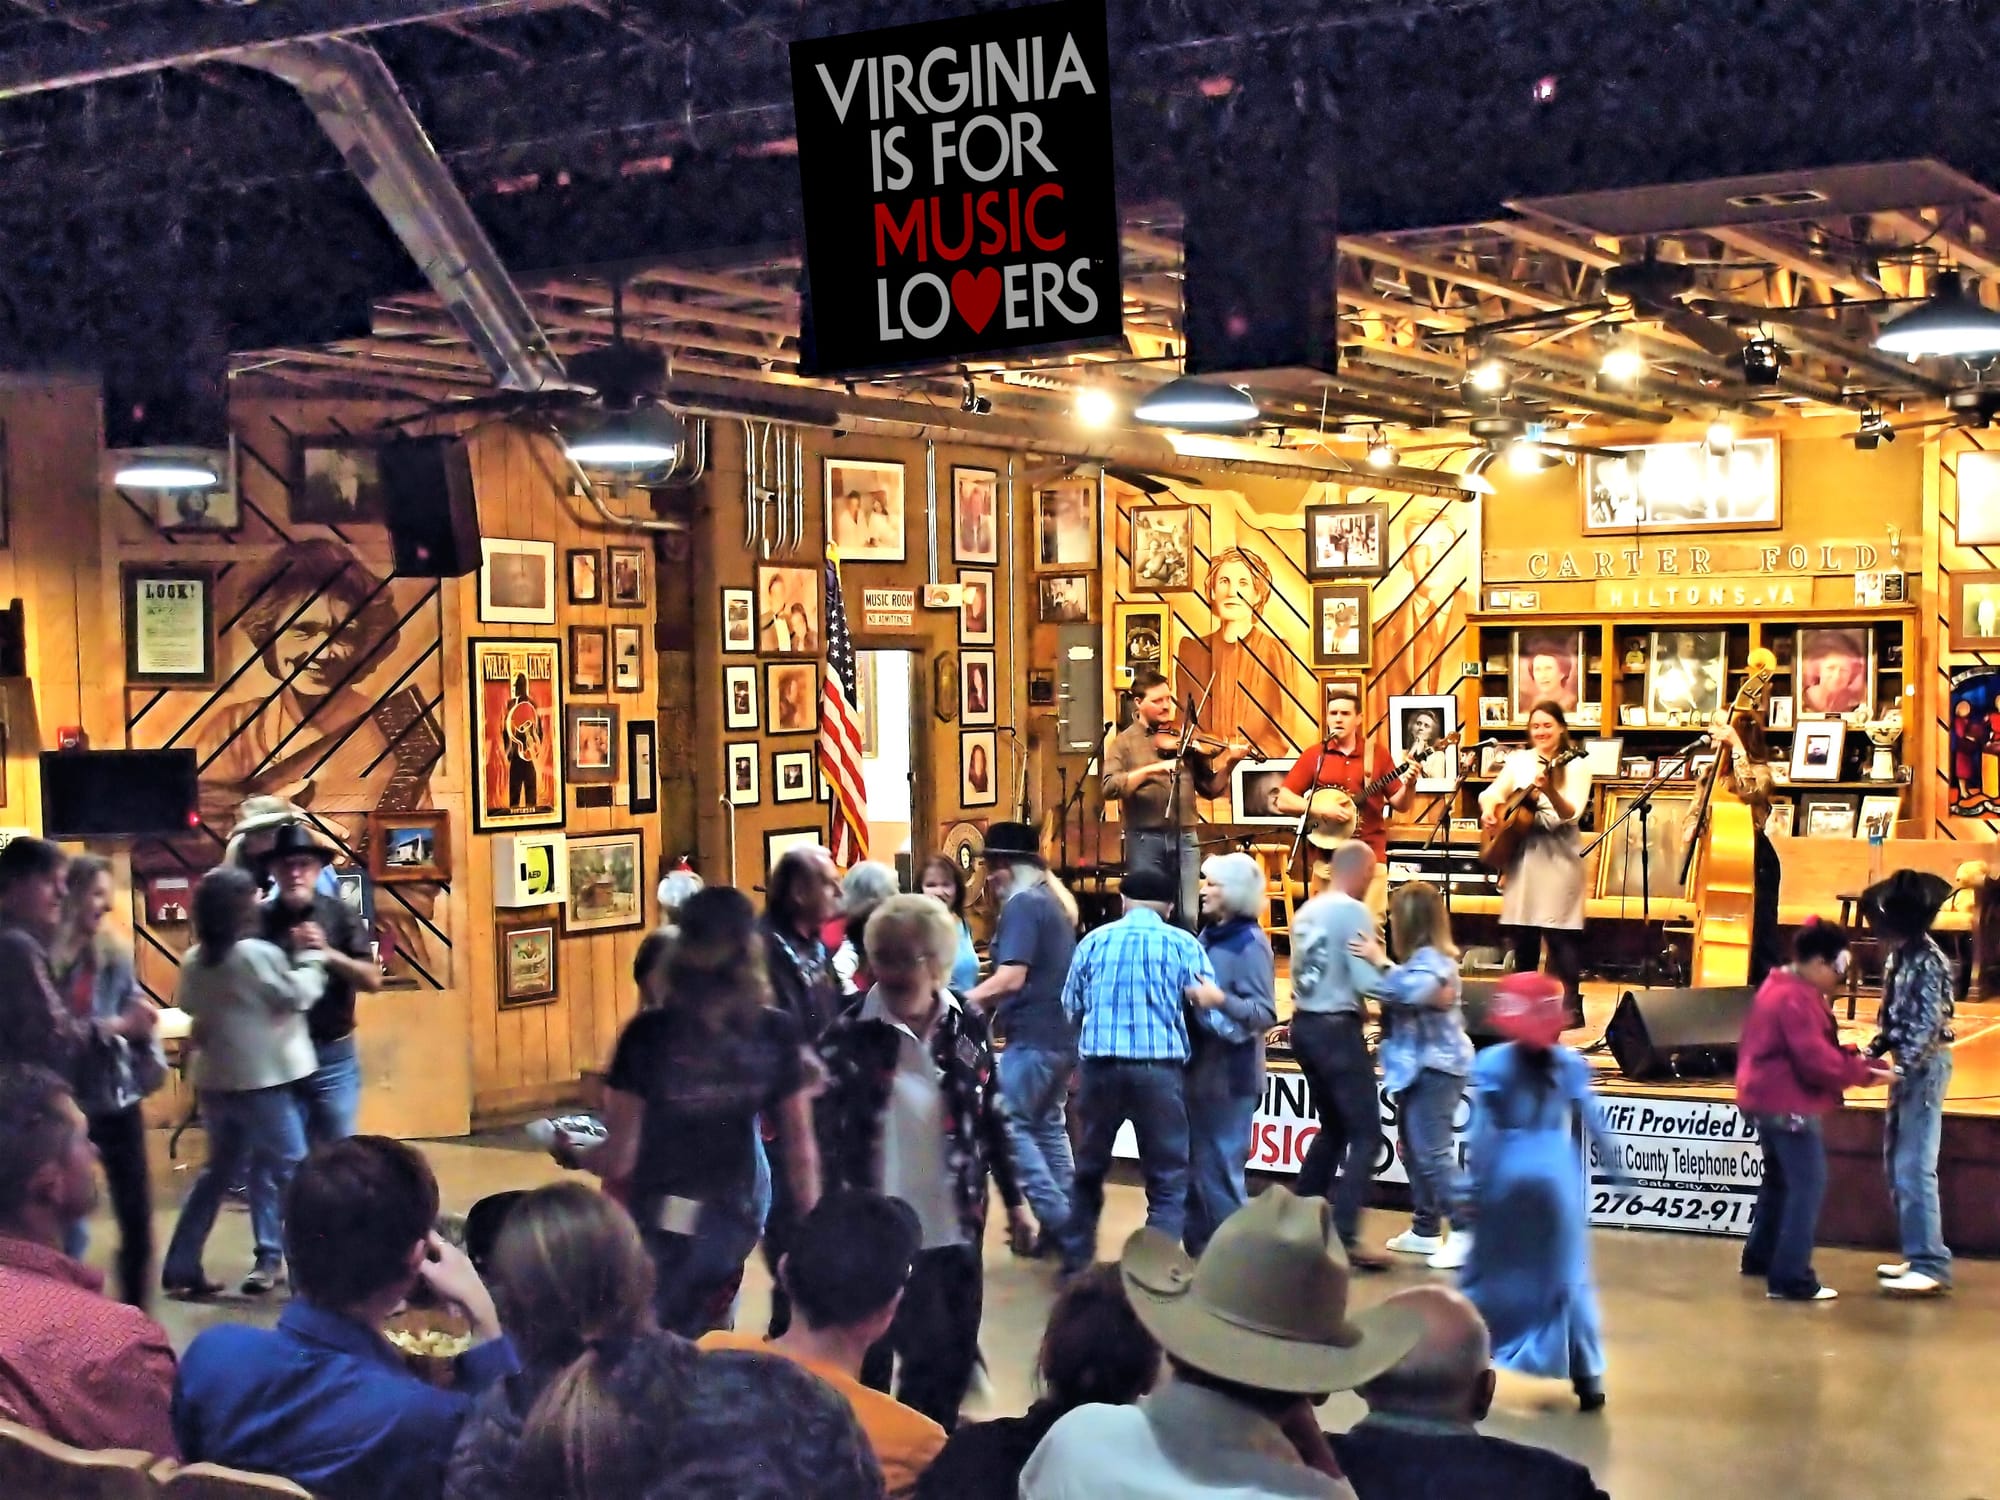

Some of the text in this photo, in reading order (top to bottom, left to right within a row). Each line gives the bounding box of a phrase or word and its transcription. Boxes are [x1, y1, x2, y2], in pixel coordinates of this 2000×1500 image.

[815, 31, 1096, 125] VIRGINIA
[870, 111, 1059, 193] IS FOR
[874, 183, 1066, 267] MUSIC
[1527, 544, 1878, 580] CARTER FOLD
[145, 583, 195, 599] LOOK!
[865, 593, 913, 607] MUSIC ROOM
[1767, 584, 1796, 605] VA
[483, 655, 510, 680] WALK
[528, 655, 553, 680] LINE
[1639, 1108, 1738, 1137] Provided
[1625, 1143, 1669, 1181] County
[1672, 1147, 1738, 1181] Telephone
[1637, 1179, 1671, 1189] Gate
[1709, 1184, 1731, 1193] VA
